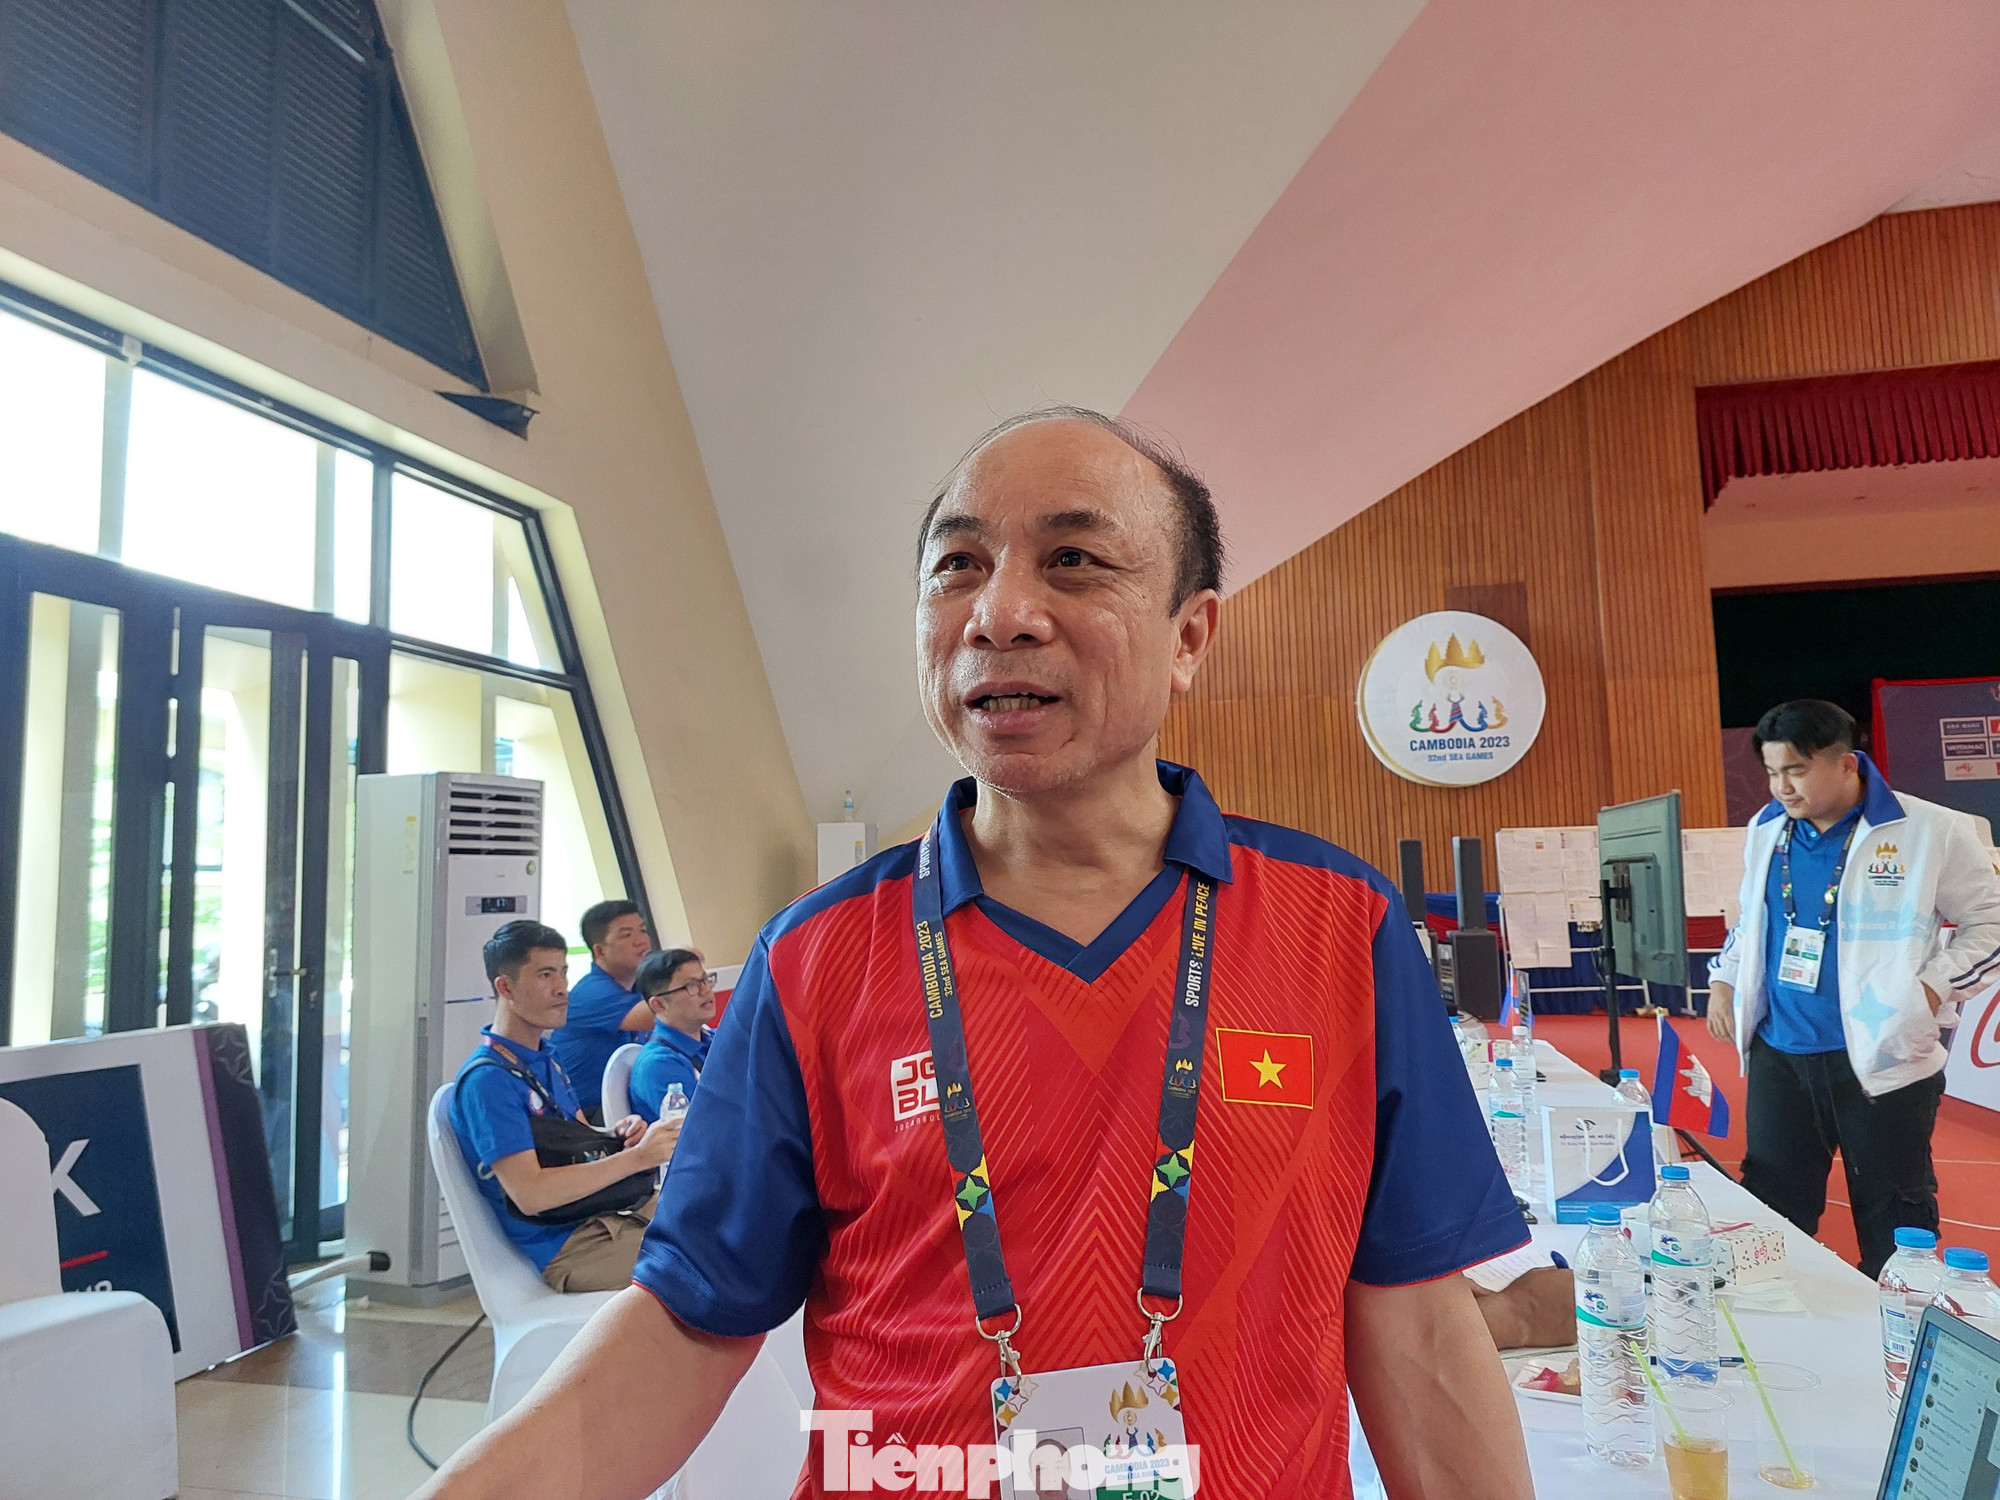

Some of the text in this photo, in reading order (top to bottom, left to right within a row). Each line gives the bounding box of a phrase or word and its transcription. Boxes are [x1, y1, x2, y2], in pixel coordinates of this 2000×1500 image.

[1410, 736, 1510, 751] CAMBODIA 2023
[1427, 751, 1494, 762] 32nd SEA GAMES
[1195, 882, 1211, 918] PEACE
[1193, 917, 1208, 932] IN
[1191, 931, 1206, 958] LIVE
[916, 920, 944, 1020] CAMBODIA 2023
[934, 931, 954, 997] 32nd SEA GAMES
[1104, 1458, 1170, 1475] CAMBODIA 2023
